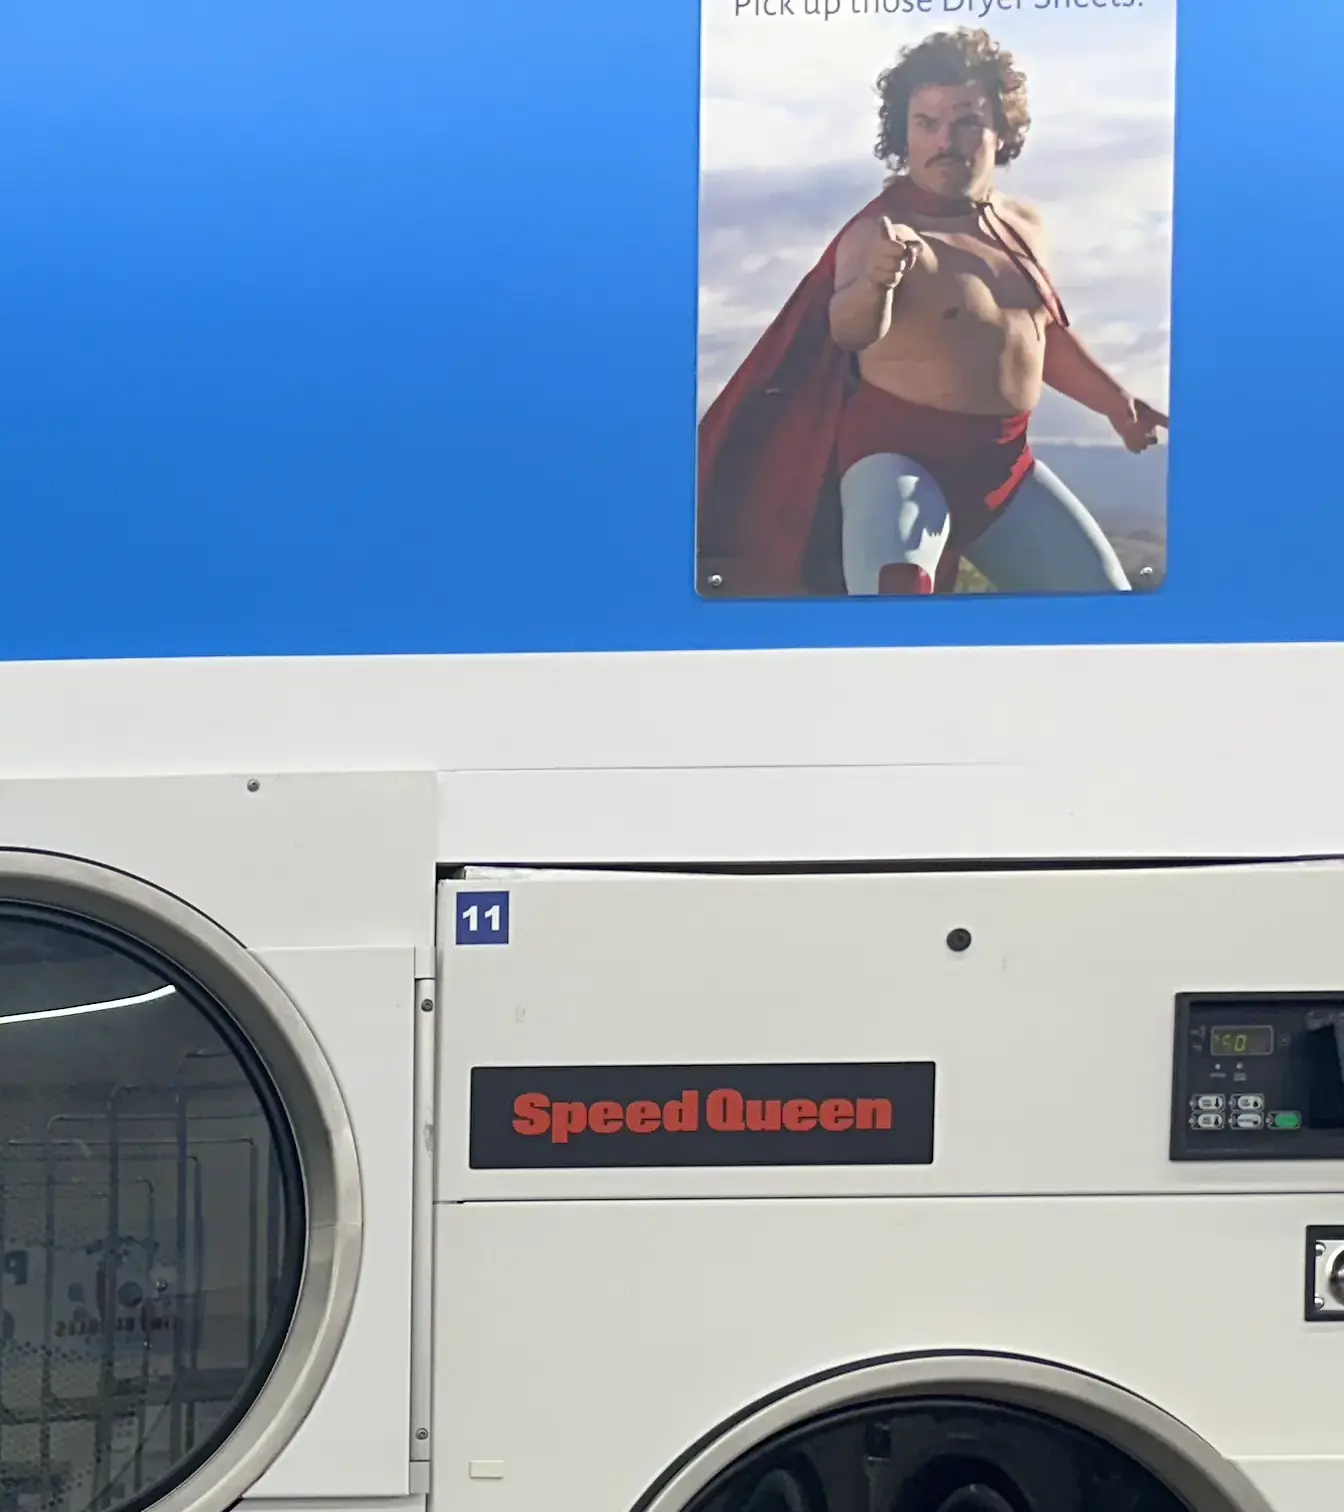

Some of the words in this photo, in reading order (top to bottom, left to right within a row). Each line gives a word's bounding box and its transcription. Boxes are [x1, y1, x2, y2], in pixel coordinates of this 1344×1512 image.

[804, 0, 842, 21] up
[462, 905, 500, 932] 11
[512, 1090, 699, 1144] Speed
[706, 1088, 893, 1132] Queen
